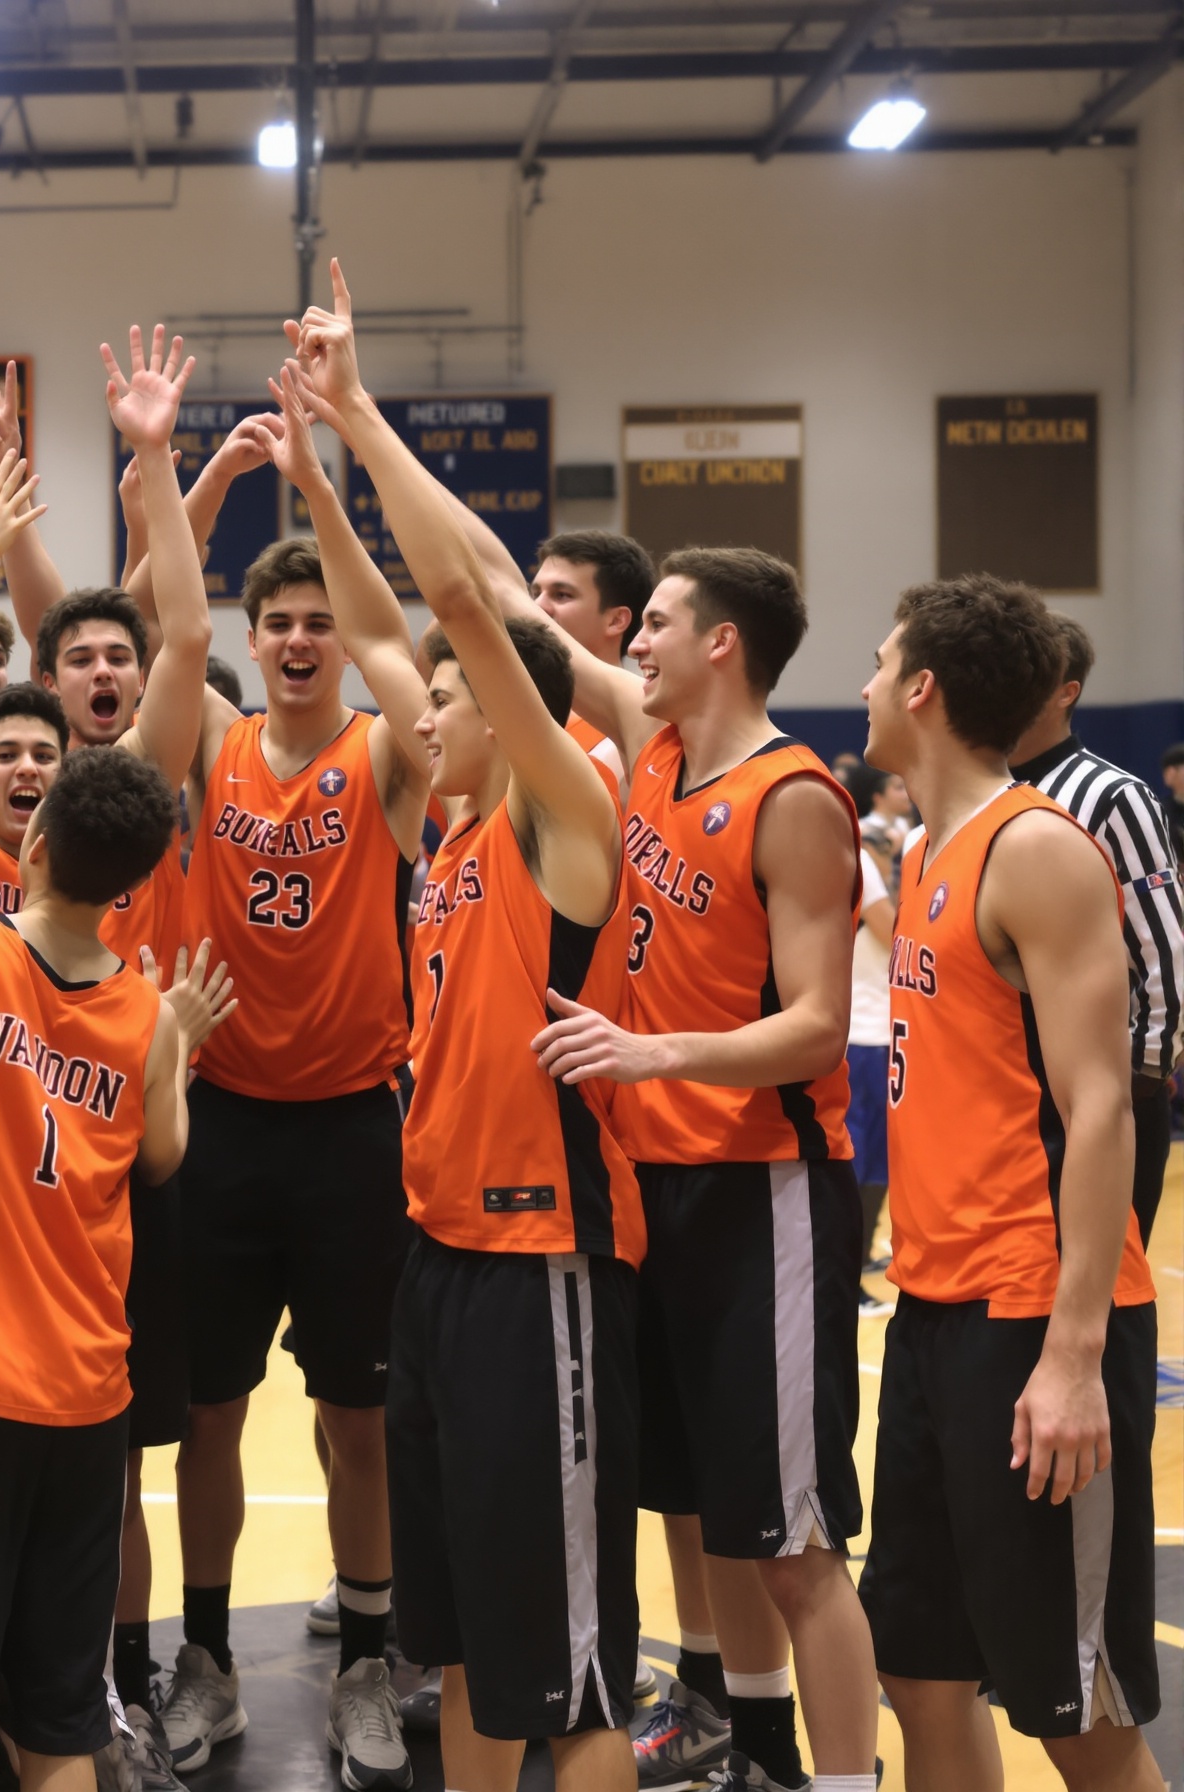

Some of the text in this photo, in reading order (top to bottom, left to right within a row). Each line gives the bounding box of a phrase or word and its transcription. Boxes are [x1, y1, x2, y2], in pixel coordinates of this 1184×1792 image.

[246, 867, 313, 931] 23
[627, 902, 656, 976] 3
[887, 1017, 910, 1110] 5
[33, 1102, 60, 1190] 1
